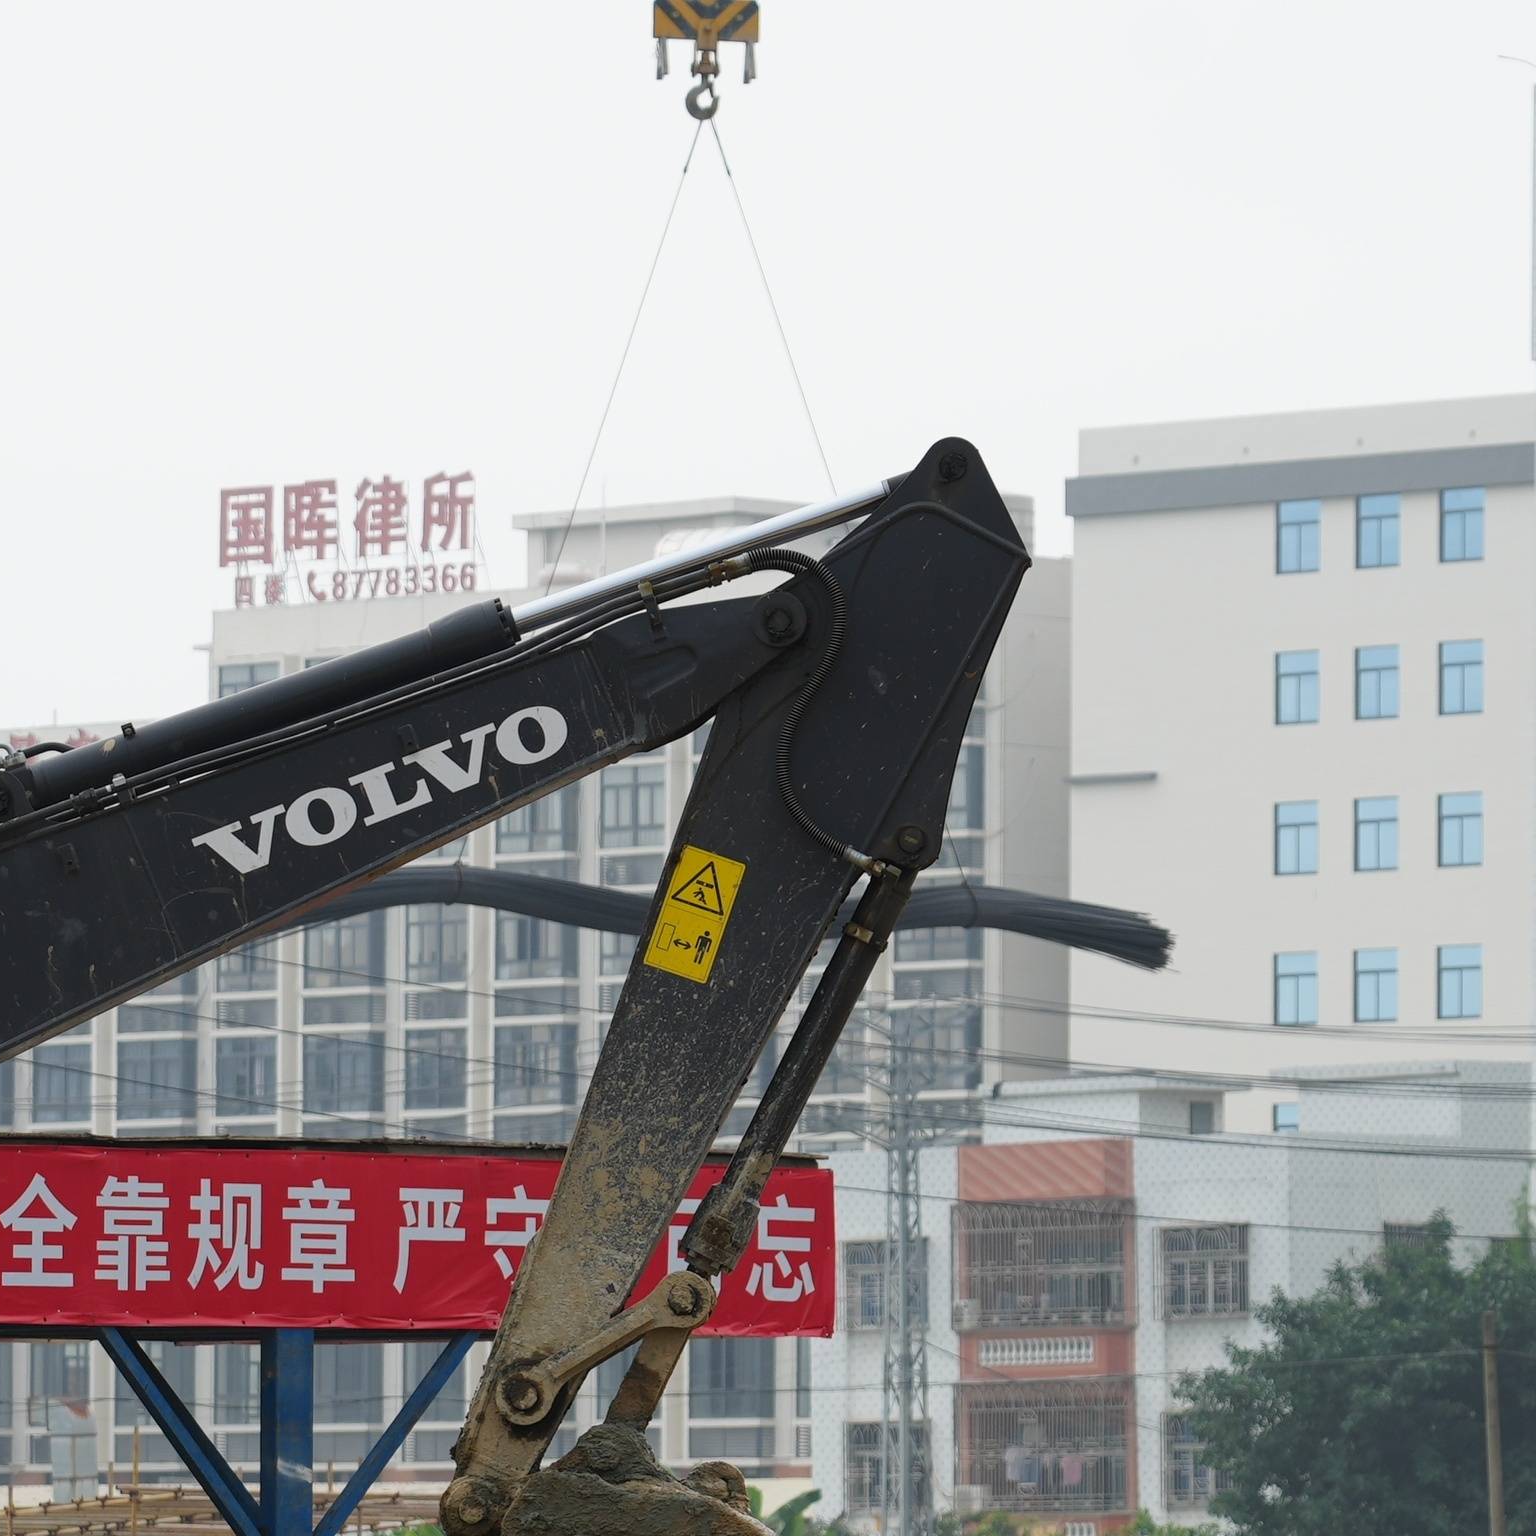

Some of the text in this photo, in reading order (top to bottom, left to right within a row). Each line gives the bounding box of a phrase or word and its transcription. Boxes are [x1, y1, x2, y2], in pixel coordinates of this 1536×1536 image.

[219, 470, 475, 567] 国晖律所
[332, 563, 476, 601] 87783366
[192, 705, 568, 875] VOLVO
